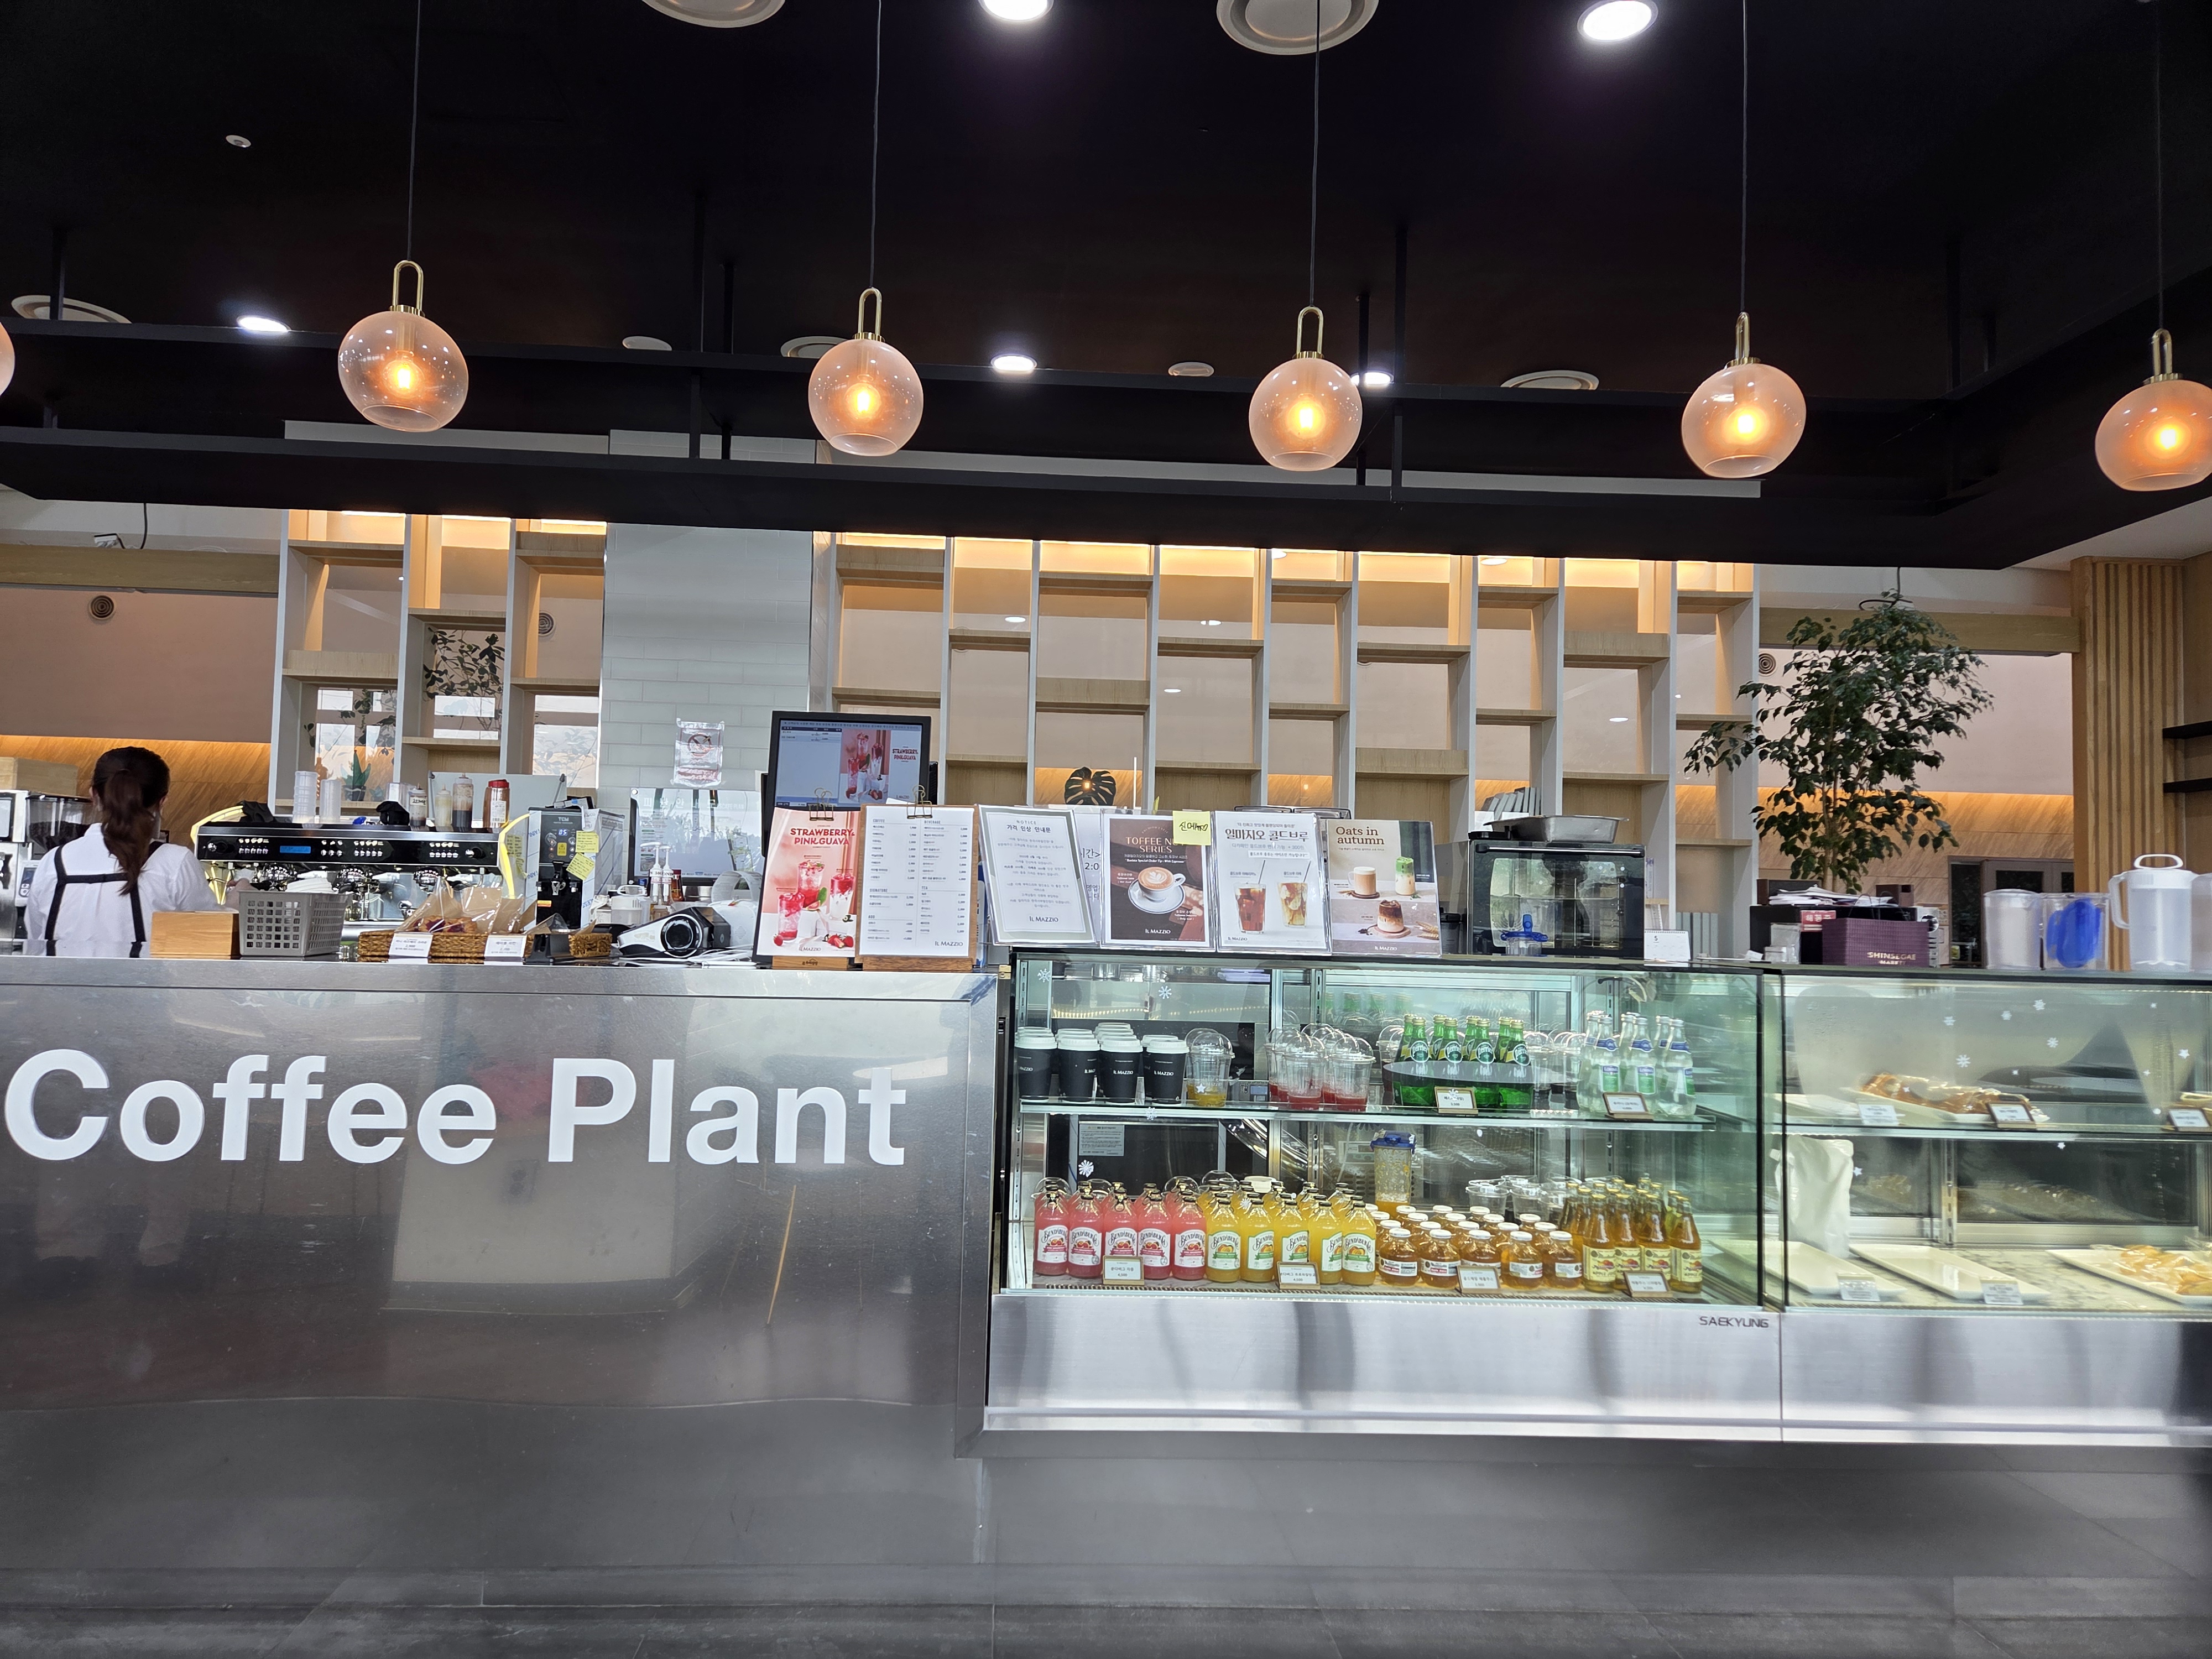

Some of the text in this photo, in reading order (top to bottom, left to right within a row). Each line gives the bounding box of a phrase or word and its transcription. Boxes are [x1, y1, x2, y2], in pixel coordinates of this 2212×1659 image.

[1225, 829, 1310, 842] 일마지오 콜드브루
[1335, 827, 1379, 836] Oats in
[1125, 837, 1162, 846] TOFFEE
[1337, 837, 1385, 845] autumn
[3, 1048, 906, 1166] Coffee Plant
[1699, 1316, 1769, 1328] SAEKYUNG
